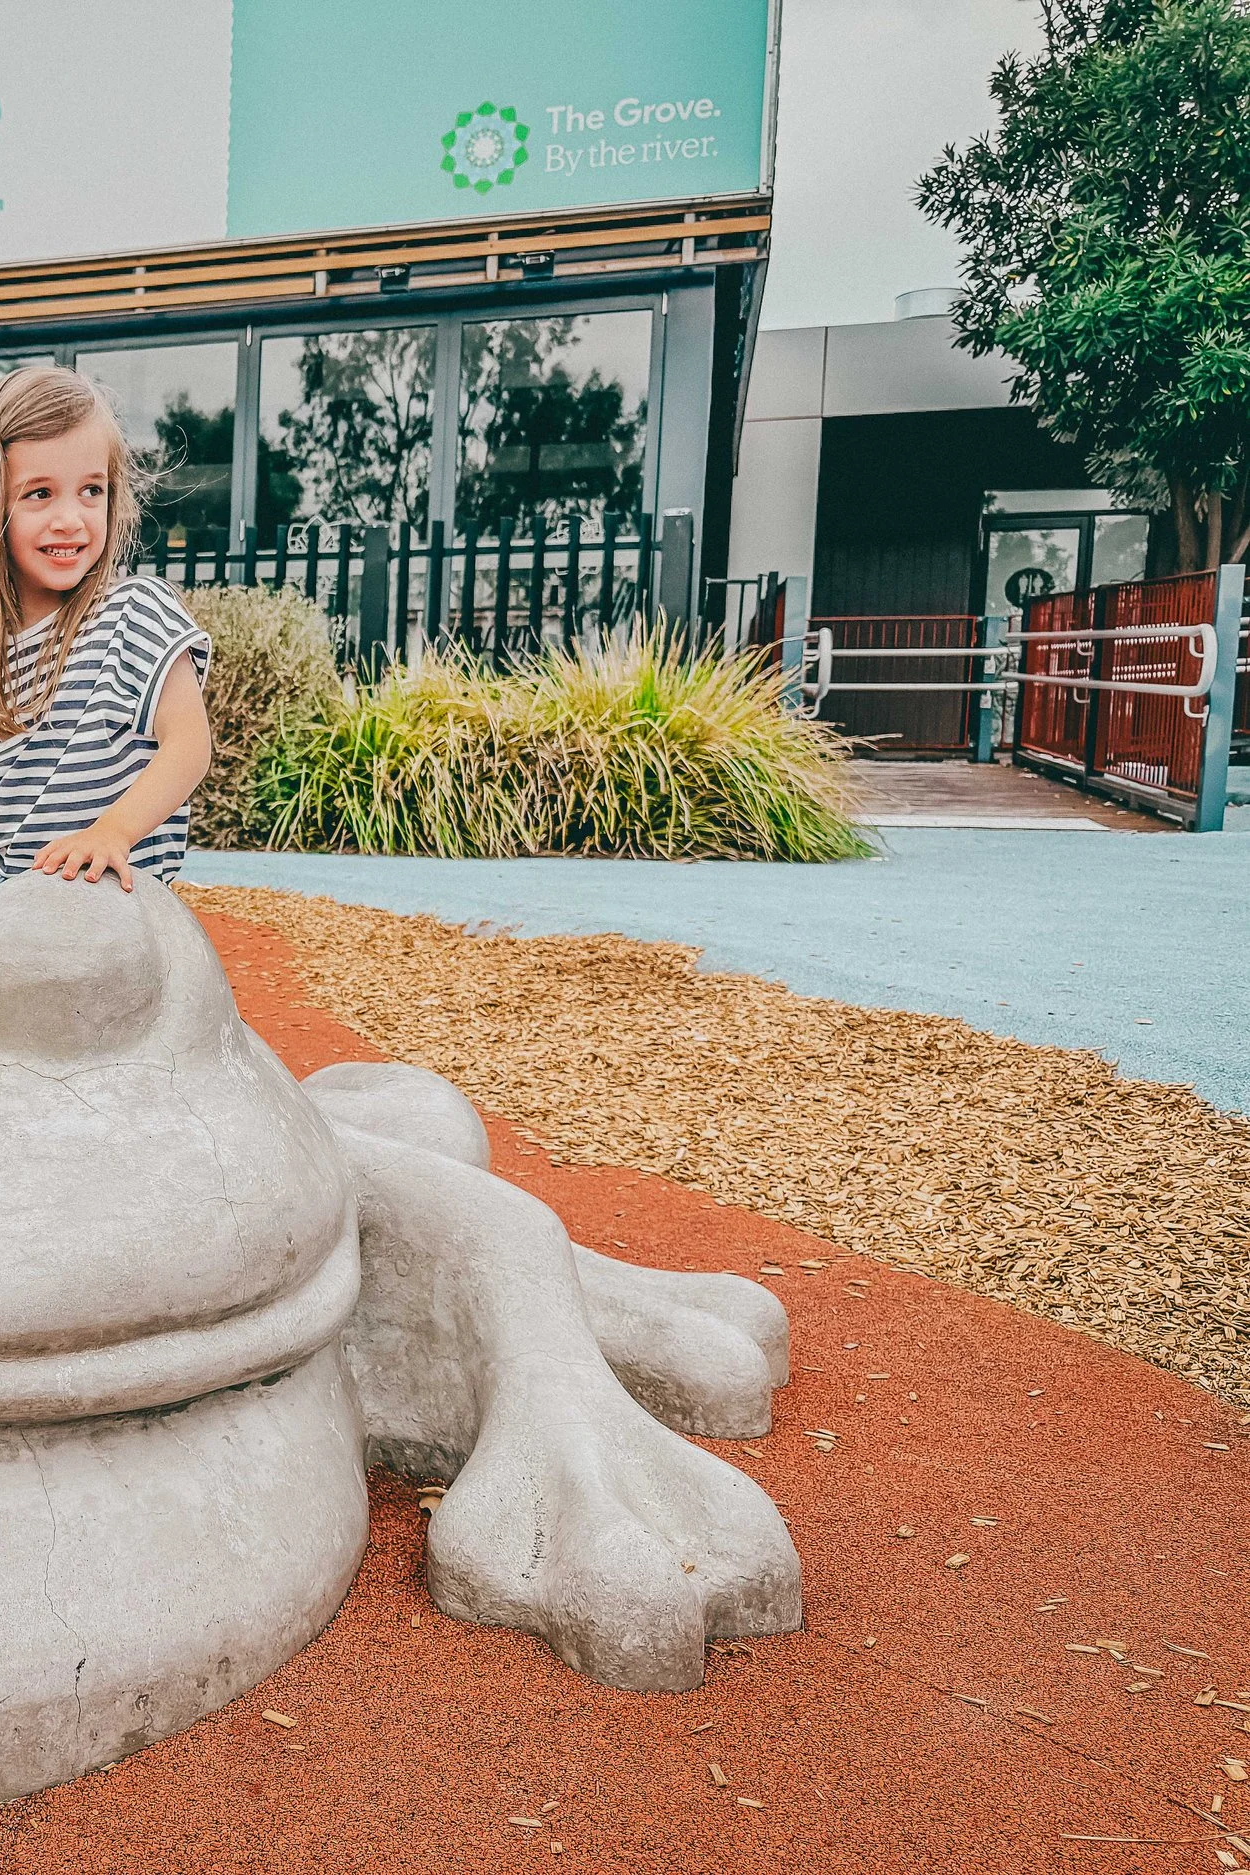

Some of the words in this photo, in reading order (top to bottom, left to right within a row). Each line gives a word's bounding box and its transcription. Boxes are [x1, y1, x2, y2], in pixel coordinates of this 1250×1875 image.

[546, 105, 604, 134] The
[614, 98, 721, 126] Grove.
[545, 144, 583, 176] By
[589, 138, 635, 168] the
[642, 134, 718, 162] river.
